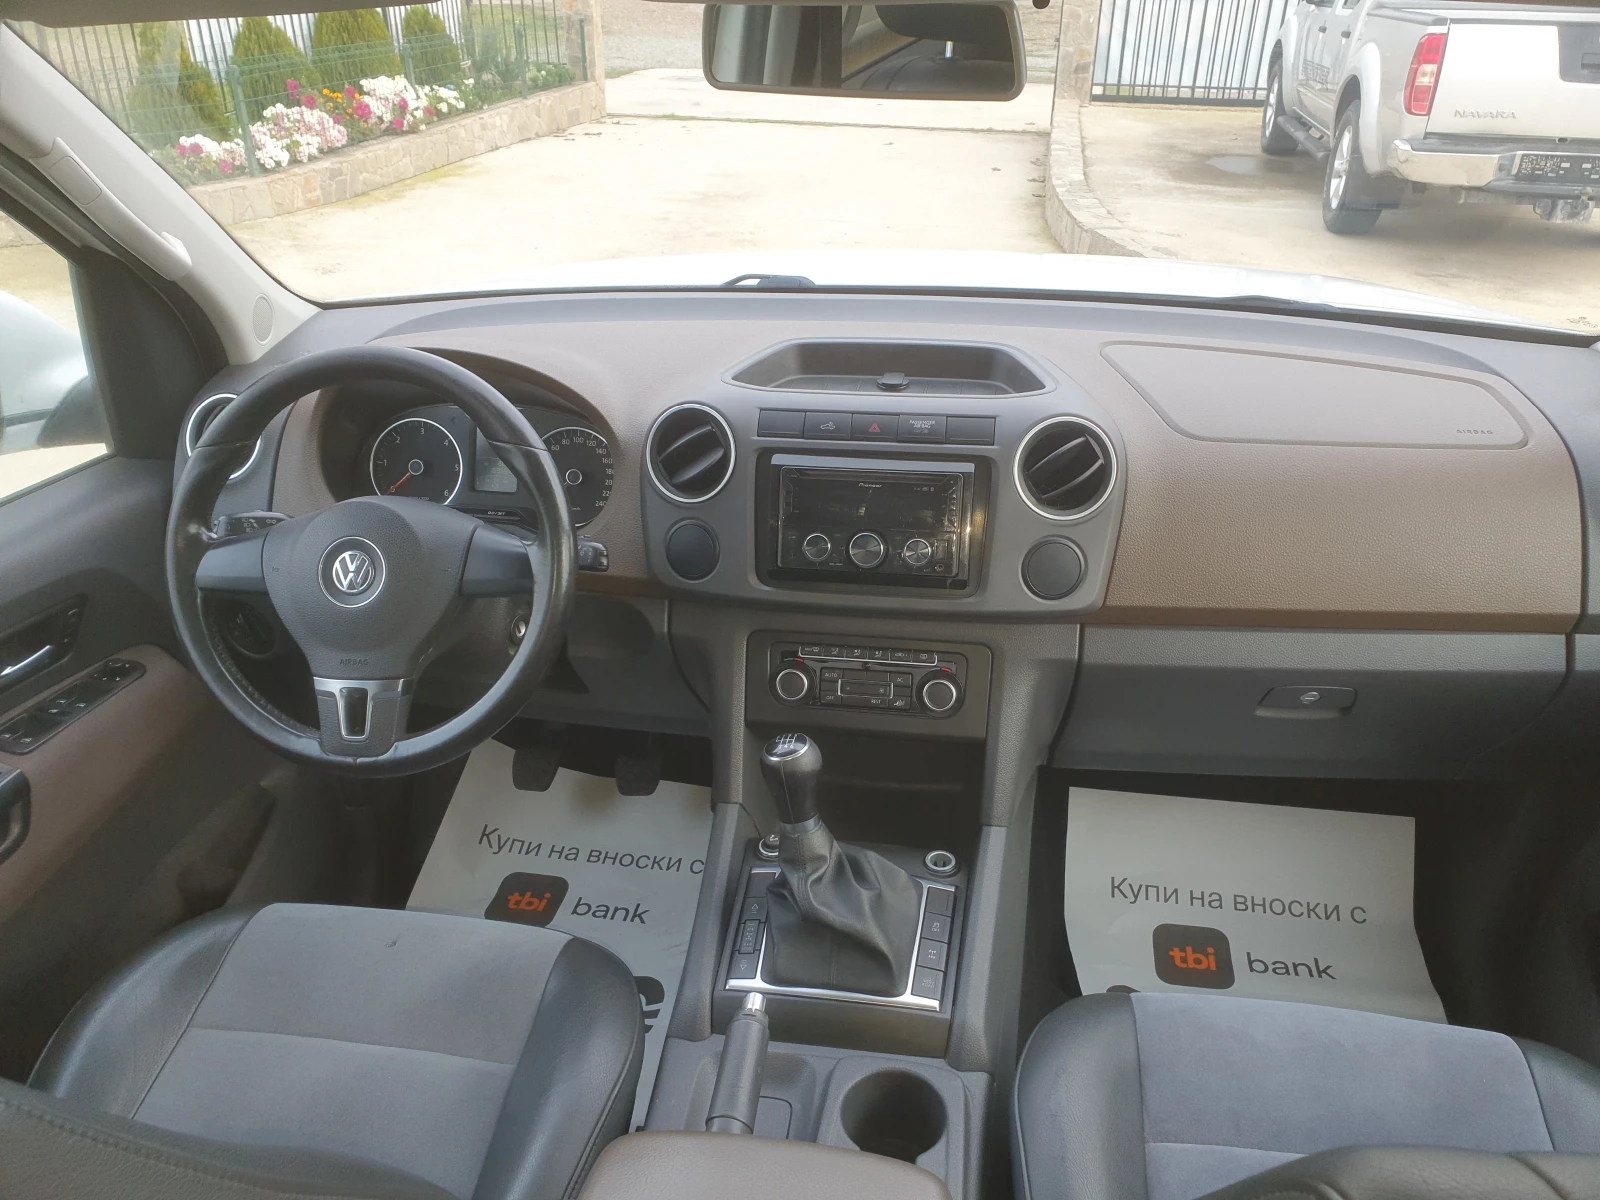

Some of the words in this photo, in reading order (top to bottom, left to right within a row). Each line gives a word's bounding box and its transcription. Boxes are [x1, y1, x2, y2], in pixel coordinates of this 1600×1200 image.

[1453, 108, 1517, 120] NAVARA
[573, 436, 584, 444] 100
[595, 447, 607, 455] 140
[339, 658, 370, 666] AIRBAG
[477, 823, 542, 857] Купи
[548, 844, 580, 861] на
[586, 849, 682, 873] вноски
[507, 891, 552, 912] tbi
[571, 897, 650, 924] bank
[1110, 876, 1179, 905] Купи
[1189, 890, 1223, 910] на
[1233, 894, 1341, 922] вноски
[1350, 906, 1367, 925] с
[1169, 946, 1217, 971] tbi
[1246, 951, 1337, 980] bank
